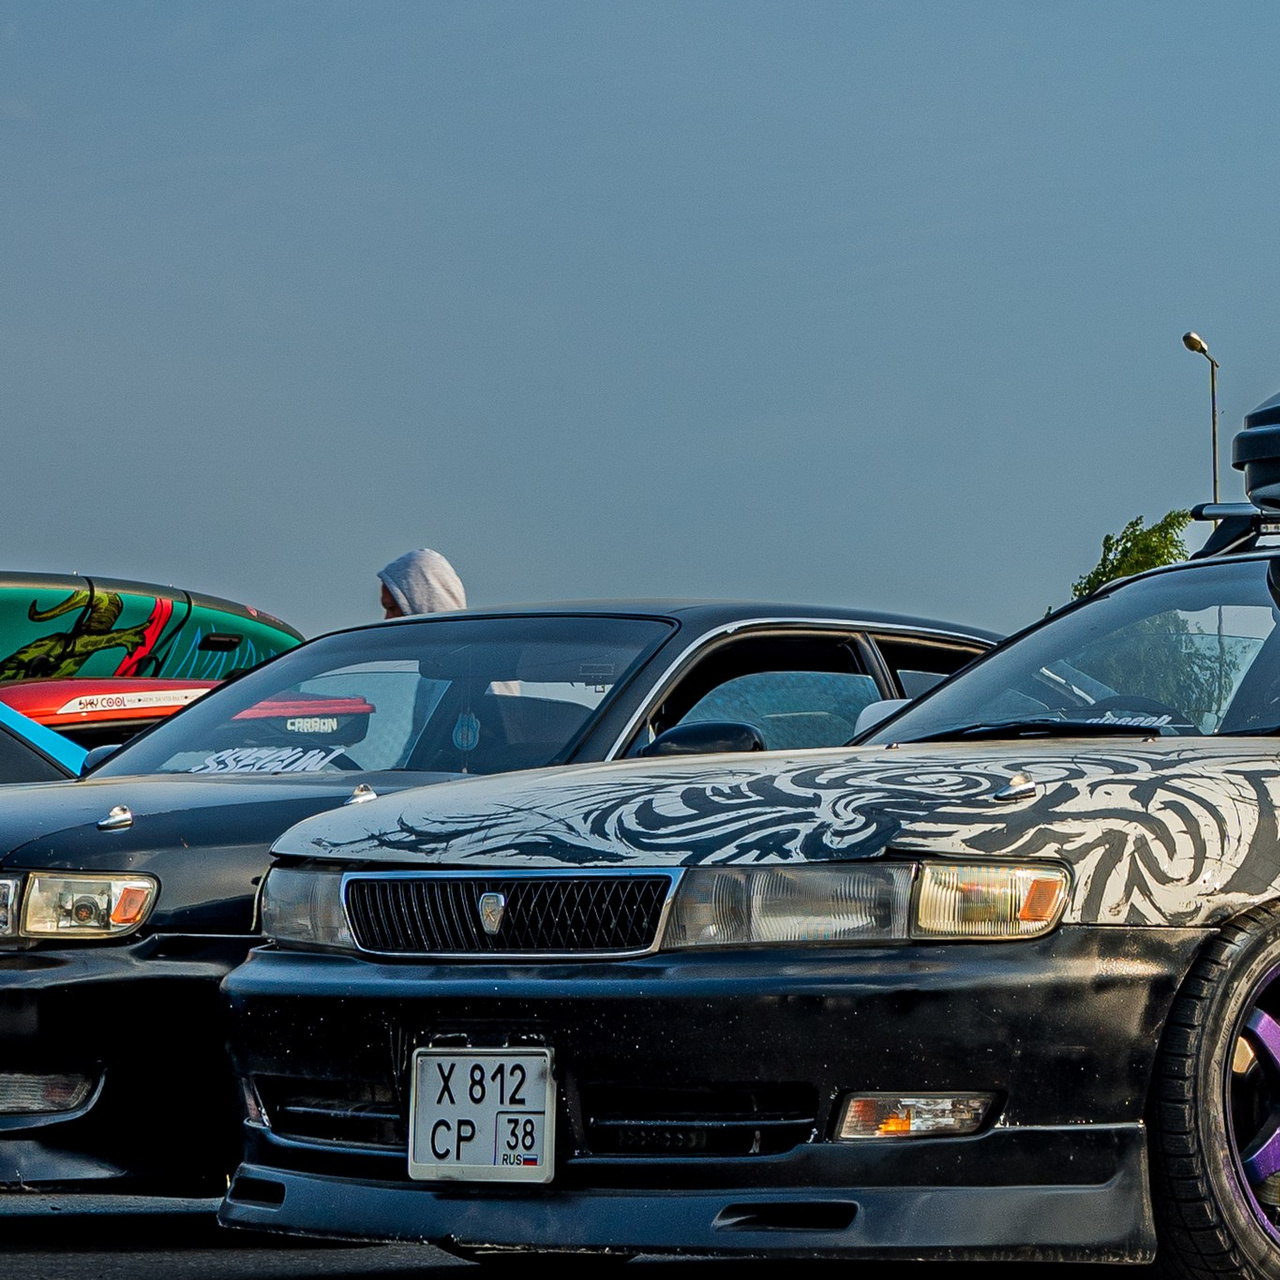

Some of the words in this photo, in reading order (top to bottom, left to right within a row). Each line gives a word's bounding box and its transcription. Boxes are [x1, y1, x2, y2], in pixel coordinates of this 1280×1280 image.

[286, 717, 338, 733] CARBON
[436, 1062, 456, 1105] X
[468, 1063, 527, 1106] 812
[430, 1119, 476, 1161] CP
[506, 1118, 536, 1151] 38
[501, 1153, 523, 1166] RUS
